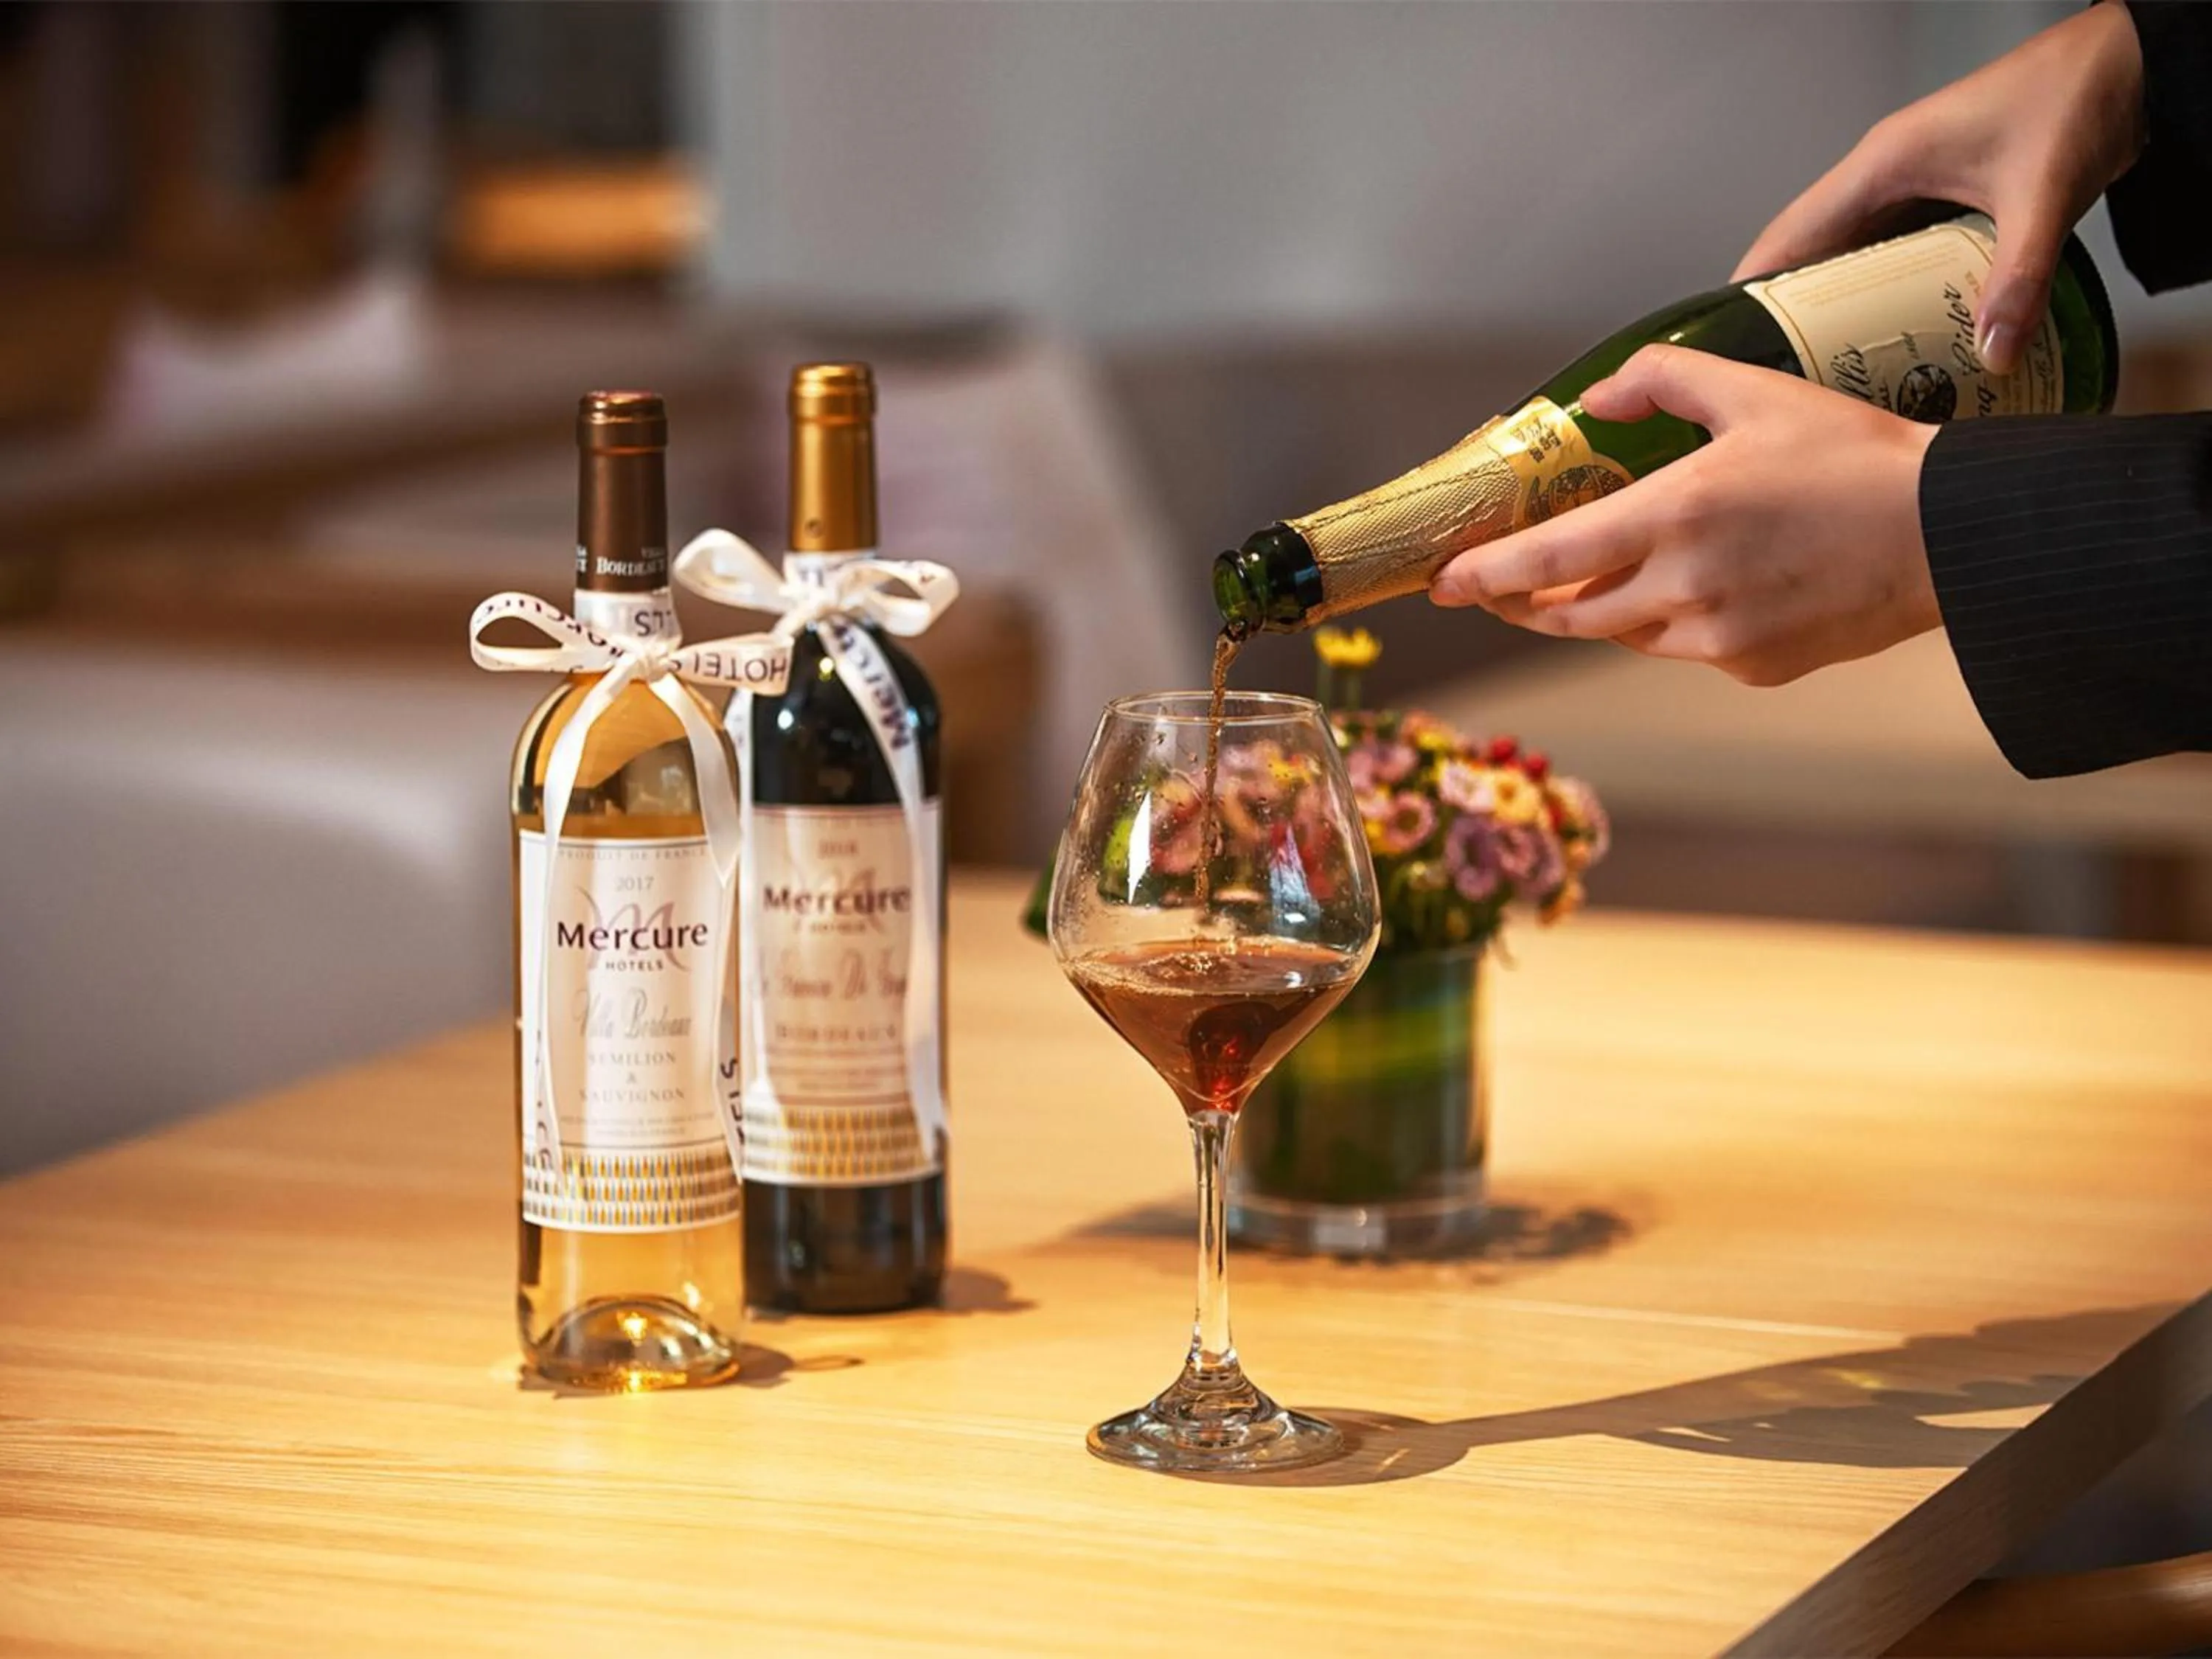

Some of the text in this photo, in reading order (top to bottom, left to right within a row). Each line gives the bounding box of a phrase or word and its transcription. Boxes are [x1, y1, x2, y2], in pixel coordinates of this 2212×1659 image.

[615, 875, 655, 892] 2017
[762, 883, 911, 914] Mercure
[557, 921, 708, 951] Mercure
[605, 960, 664, 972] HOTELS
[579, 1088, 686, 1103] SAUVIGNON
